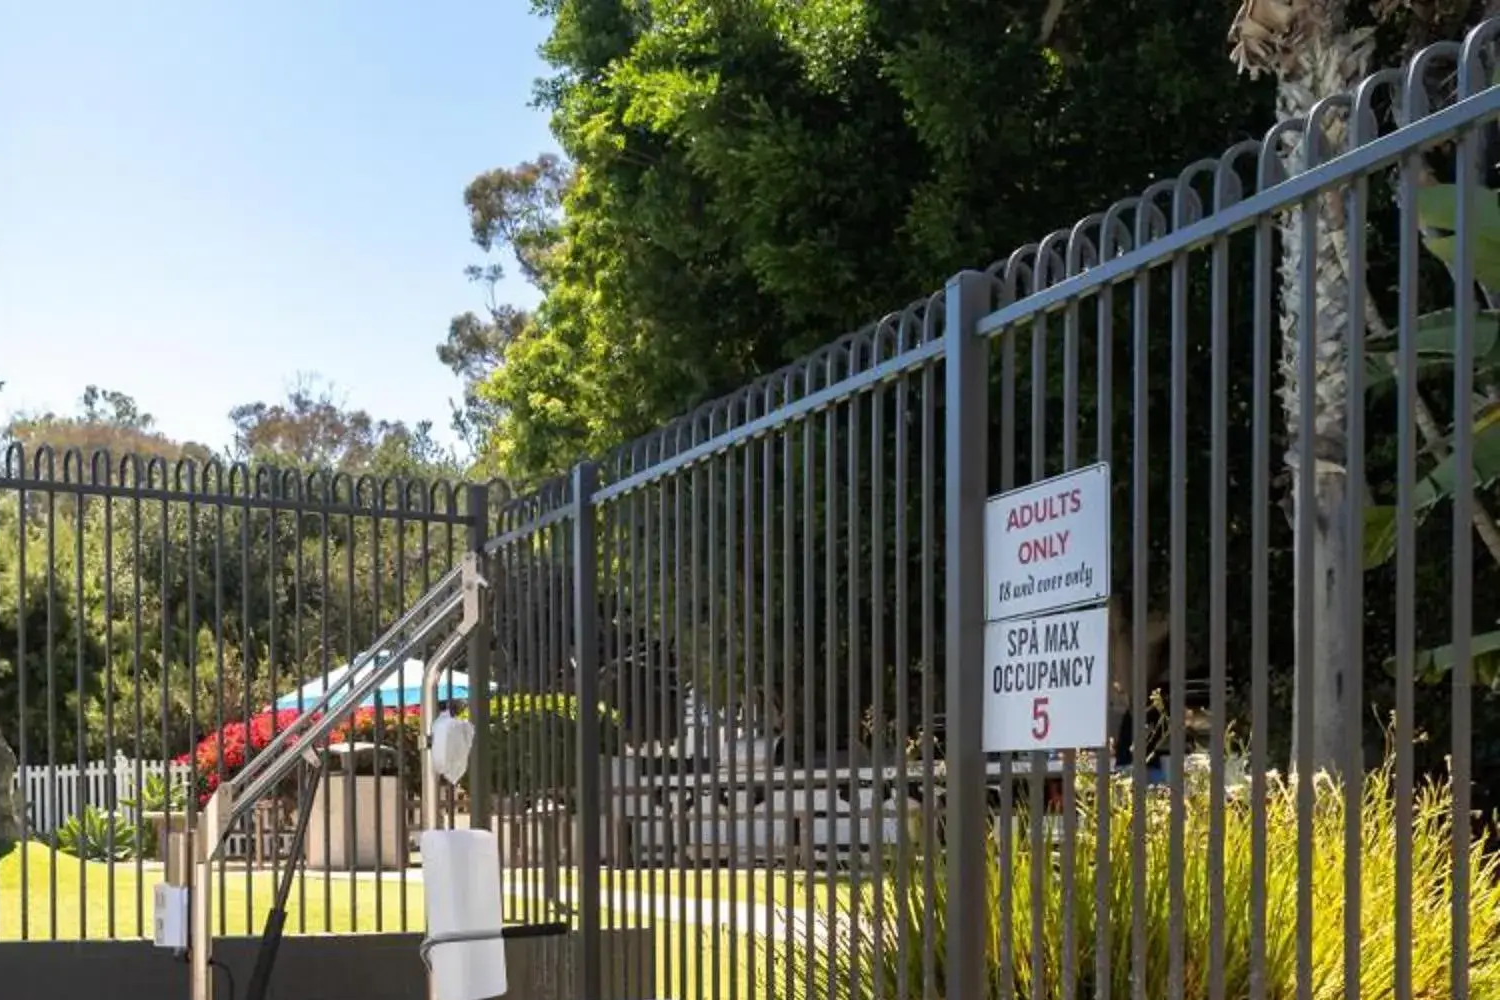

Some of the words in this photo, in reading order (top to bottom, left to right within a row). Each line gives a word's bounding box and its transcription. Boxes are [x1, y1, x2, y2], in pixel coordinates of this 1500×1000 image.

[1005, 488, 1082, 532] ADULTS
[1018, 530, 1070, 565] ONLY
[999, 580, 1012, 603] 18
[1013, 574, 1035, 599] and
[1037, 575, 1063, 594] over
[1065, 561, 1093, 588] only
[1007, 624, 1039, 656] SPA
[1043, 620, 1080, 653] MAX
[993, 656, 1095, 694] OCCUPANCY
[1031, 697, 1050, 740] 5
